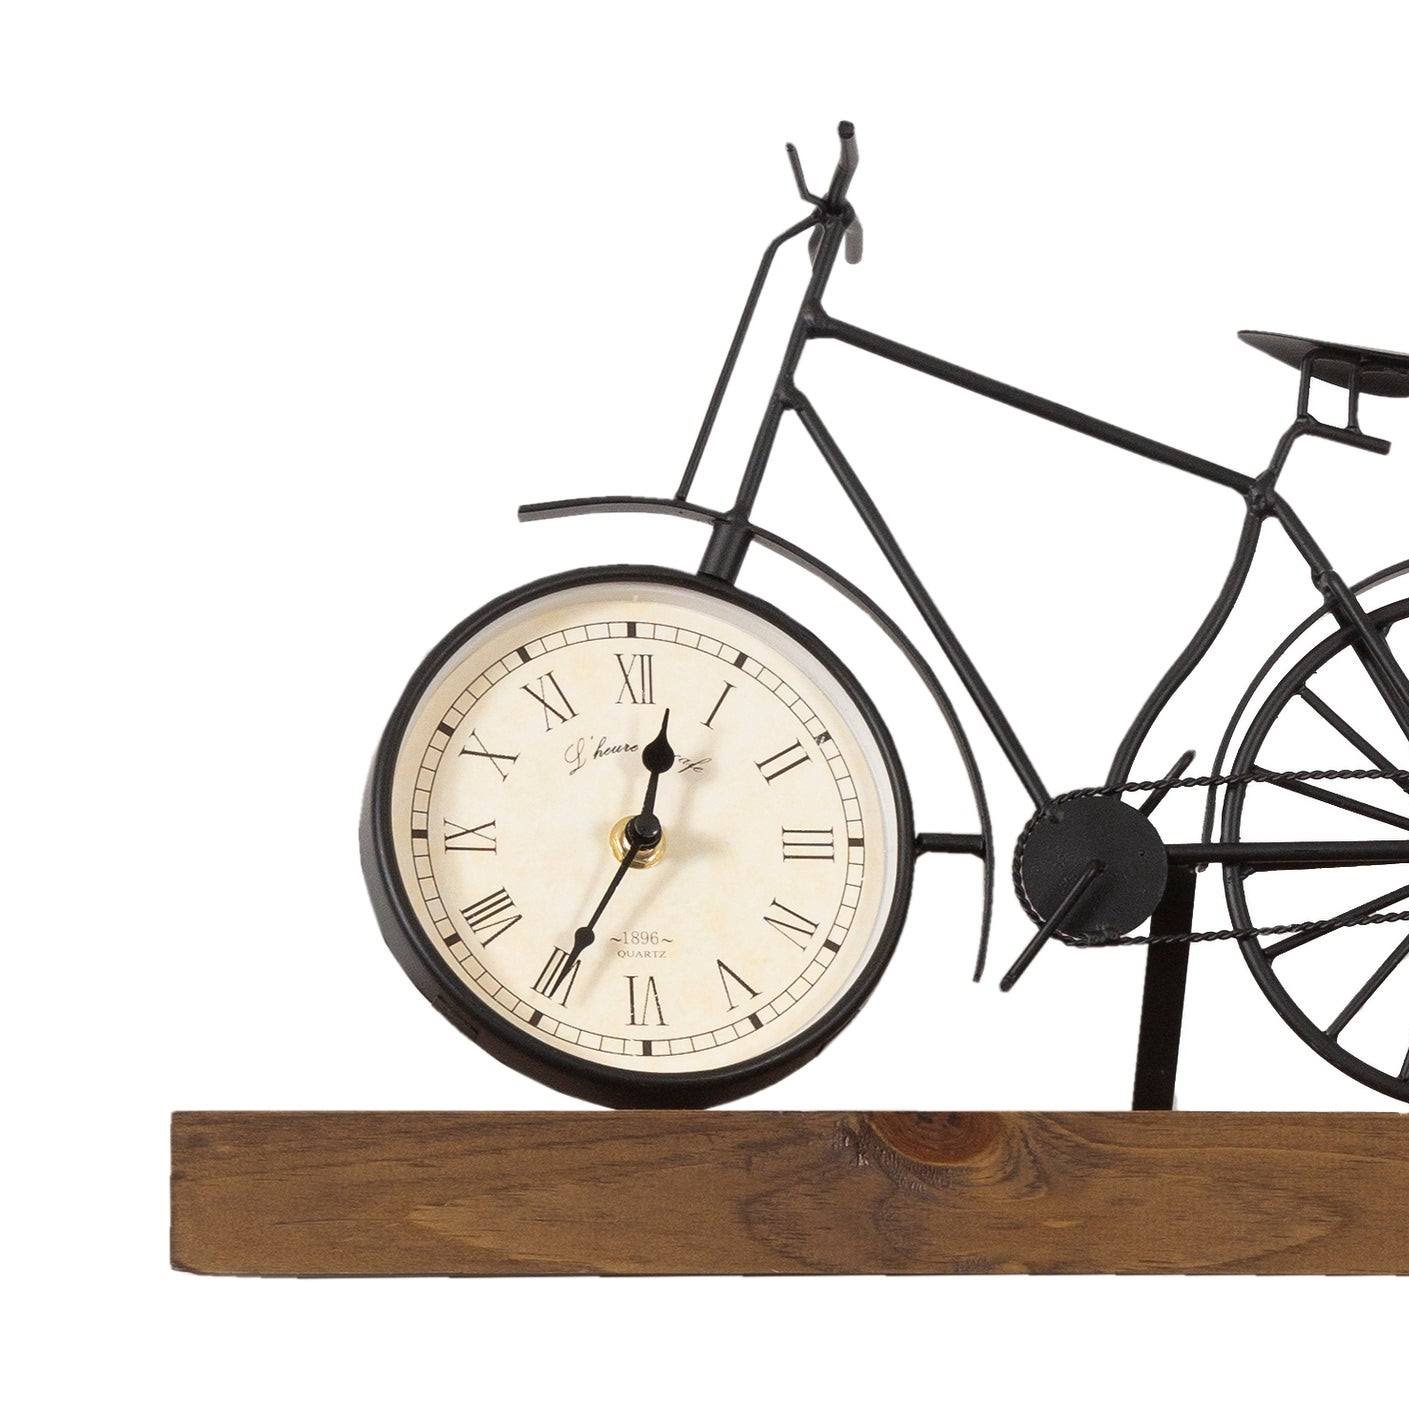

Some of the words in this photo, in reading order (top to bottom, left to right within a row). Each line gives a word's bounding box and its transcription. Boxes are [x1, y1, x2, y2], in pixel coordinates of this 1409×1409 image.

[520, 670, 579, 732] XI
[614, 653, 656, 705] XII
[459, 728, 520, 781] X
[755, 738, 812, 784] II
[781, 826, 835, 863] III
[459, 886, 523, 949] VIII
[617, 950, 667, 959] QUARTZ
[625, 975, 668, 1027] VI
[716, 959, 762, 1012] V
